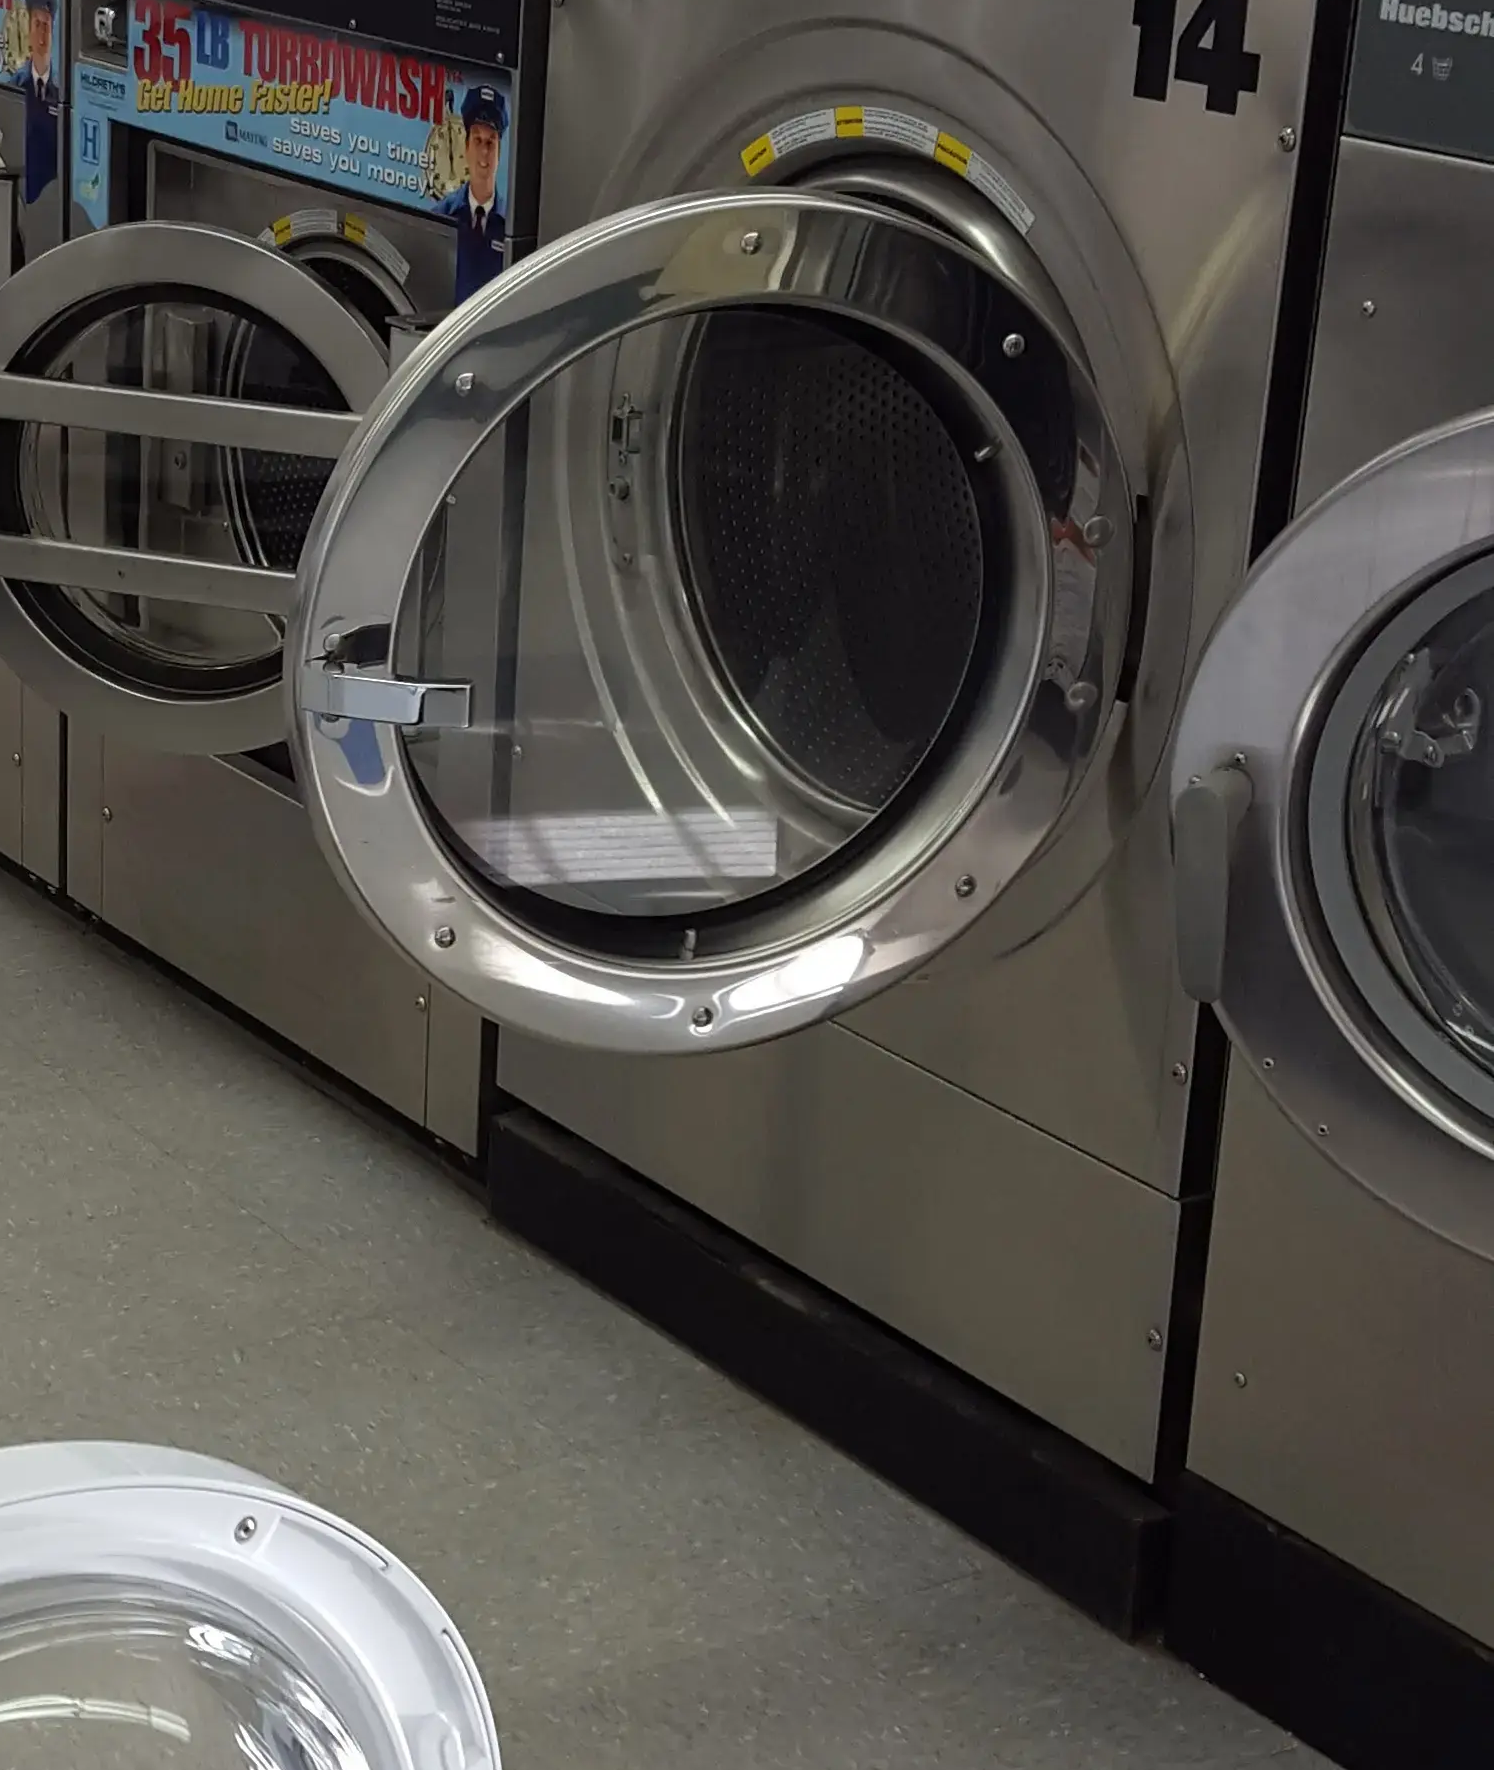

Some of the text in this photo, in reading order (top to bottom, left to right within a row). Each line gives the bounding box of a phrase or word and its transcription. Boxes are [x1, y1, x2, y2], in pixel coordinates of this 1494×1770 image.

[195, 10, 230, 70] LB
[239, 19, 447, 125] TURBOWASH
[1410, 53, 1424, 75] 4
[137, 79, 172, 114] Get
[178, 80, 244, 114] Home
[249, 79, 333, 115] Faster!
[271, 137, 435, 199] saves you money!
[290, 117, 436, 169] saves you time!
